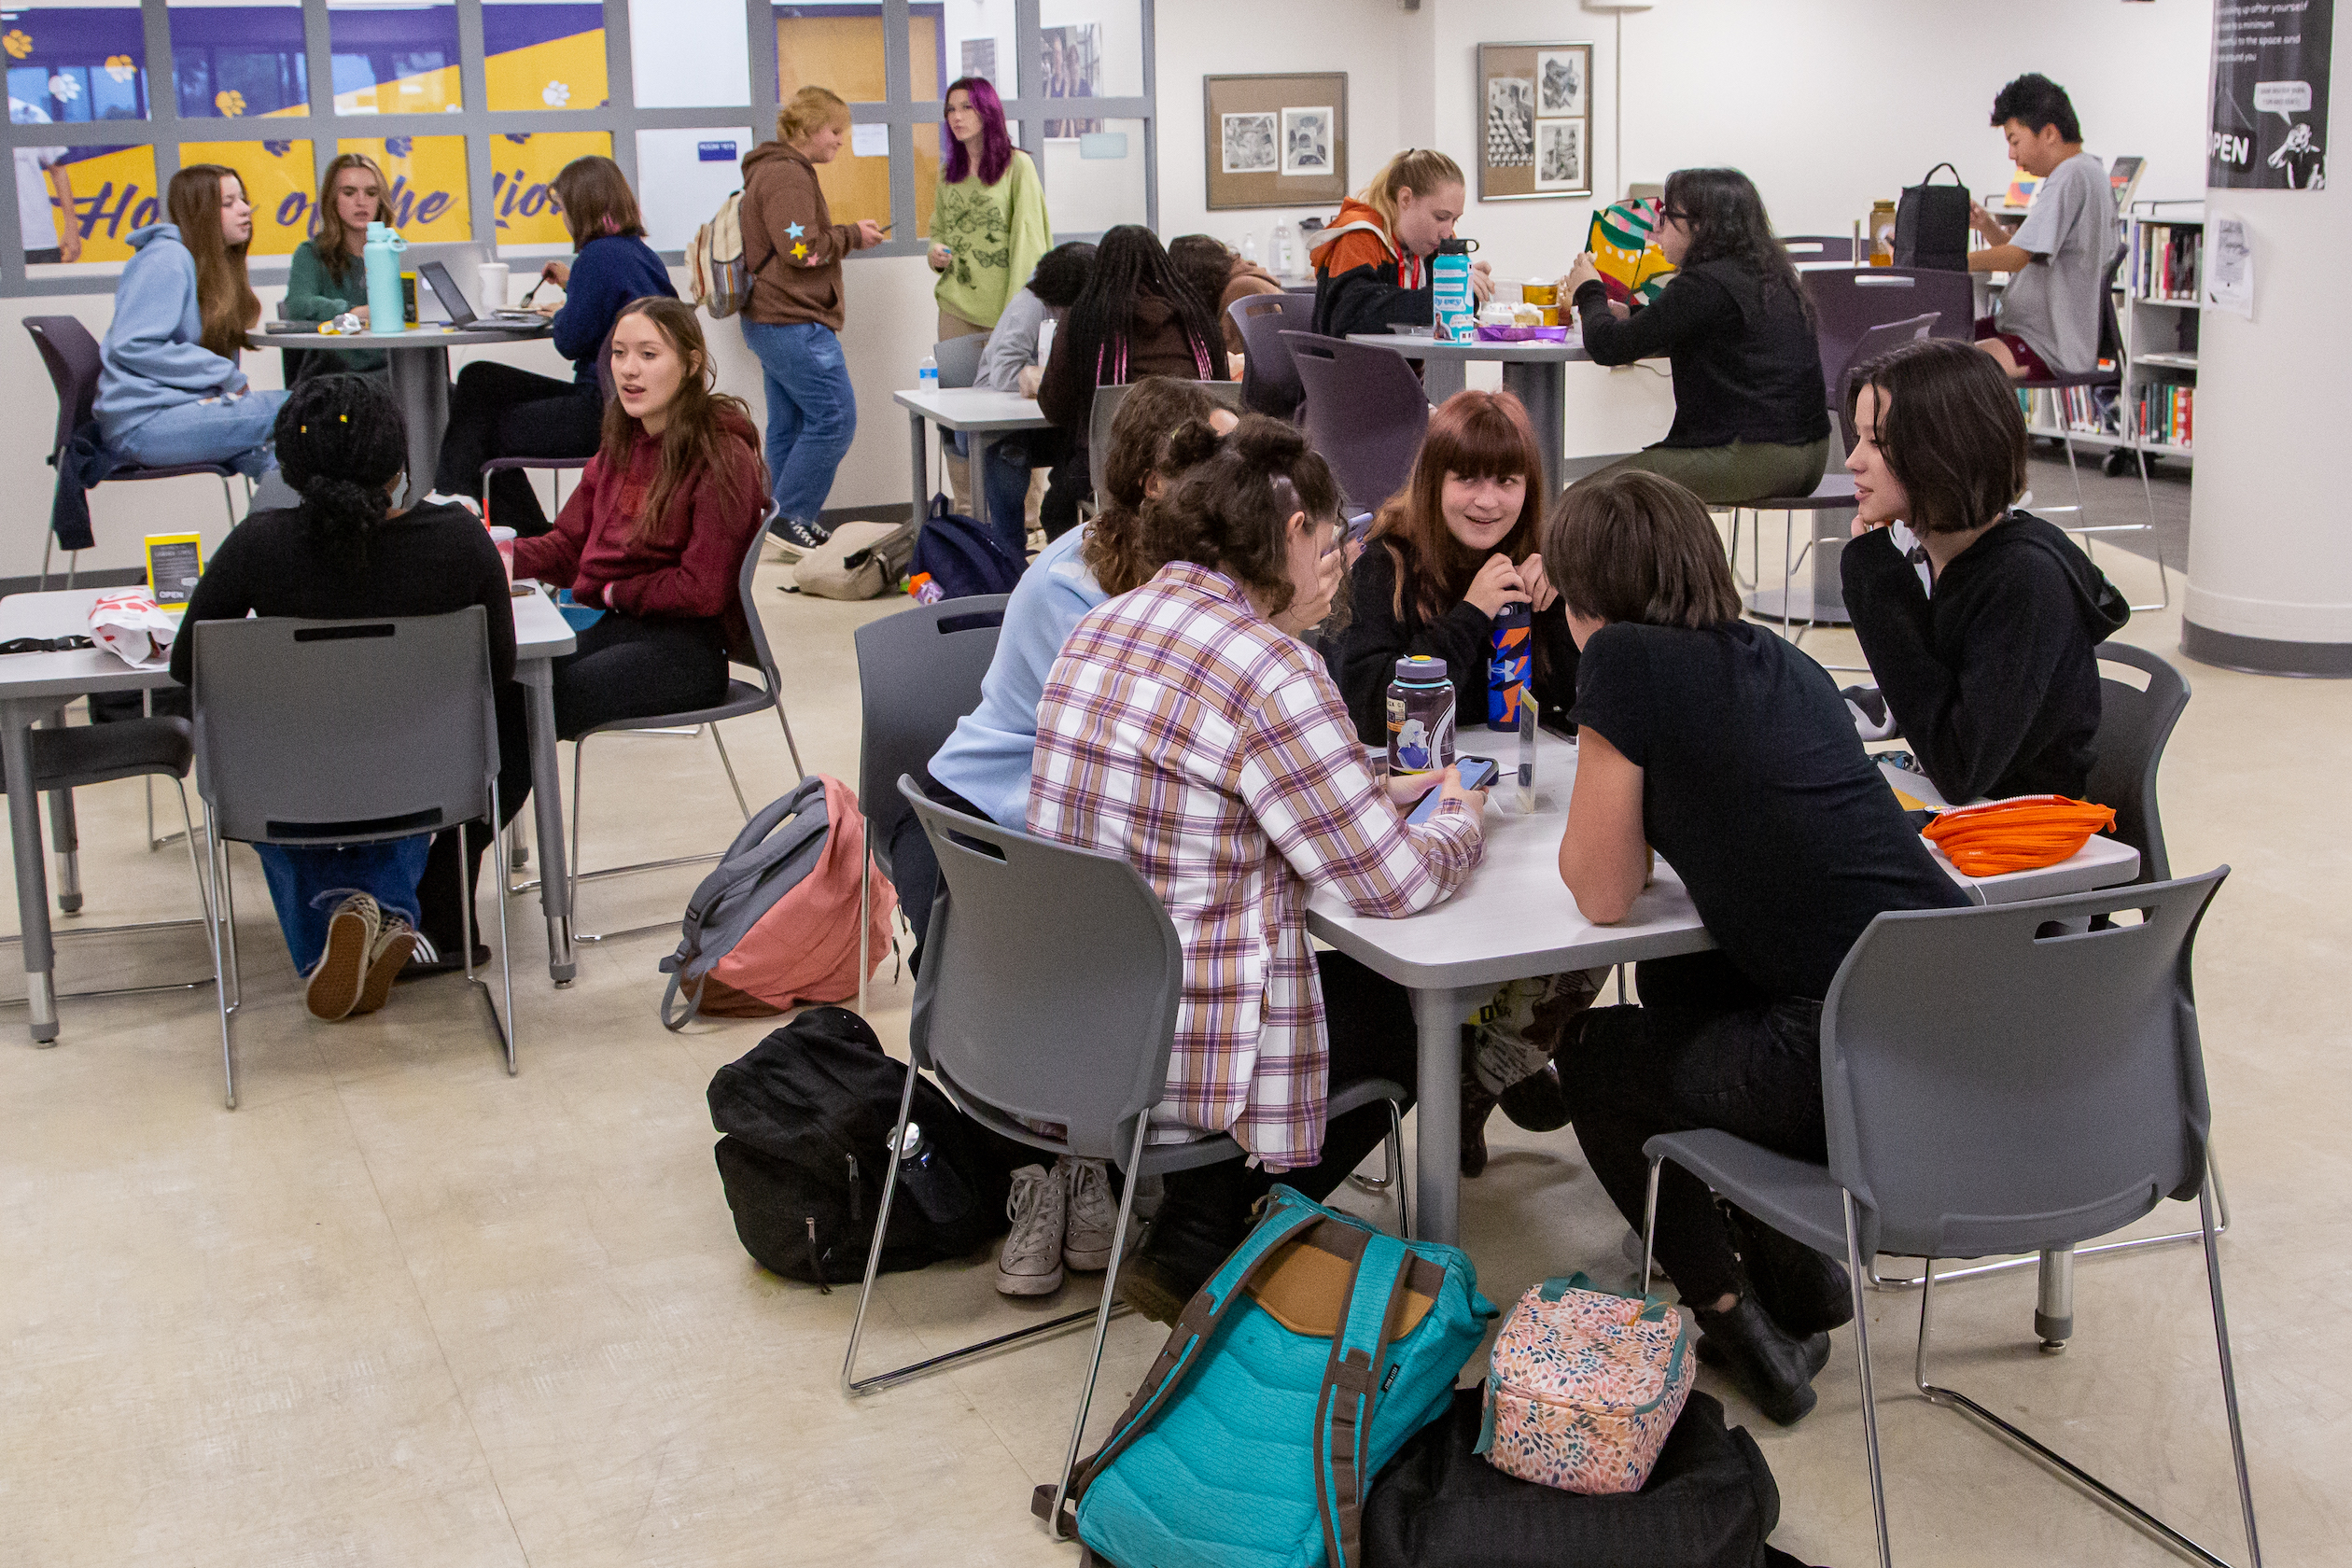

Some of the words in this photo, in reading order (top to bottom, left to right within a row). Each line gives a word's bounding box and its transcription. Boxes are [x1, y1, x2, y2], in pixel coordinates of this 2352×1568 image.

[2250, 3, 2270, 13] after
[2272, 0, 2309, 14] yourself
[2244, 21, 2275, 30] minimum
[2246, 36, 2258, 45] the
[2259, 36, 2282, 48] space
[2283, 33, 2302, 45] and
[2245, 53, 2257, 63] you
[389, 175, 459, 230] he
[159, 591, 185, 599] OPEN
